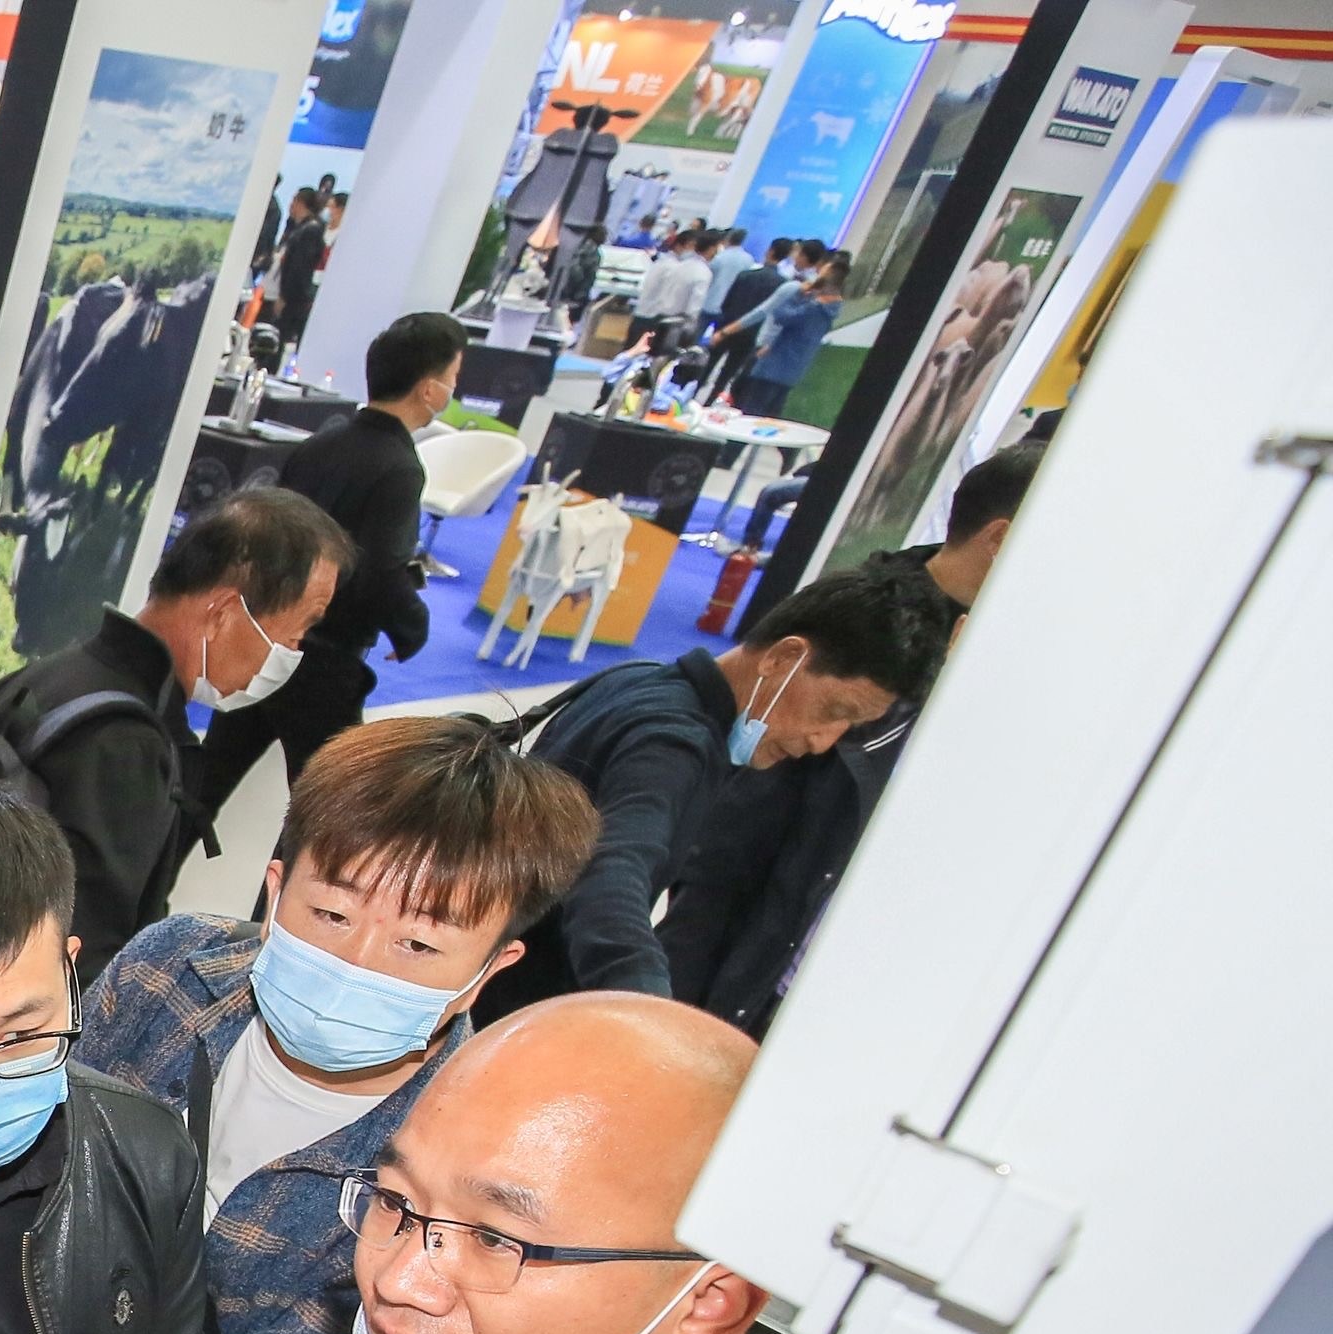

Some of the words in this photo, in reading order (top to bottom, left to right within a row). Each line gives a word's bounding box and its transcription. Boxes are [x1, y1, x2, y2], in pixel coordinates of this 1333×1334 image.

[553, 40, 620, 94] NL
[1060, 78, 1131, 122] WAIKATO
[207, 111, 246, 141] 奶牛
